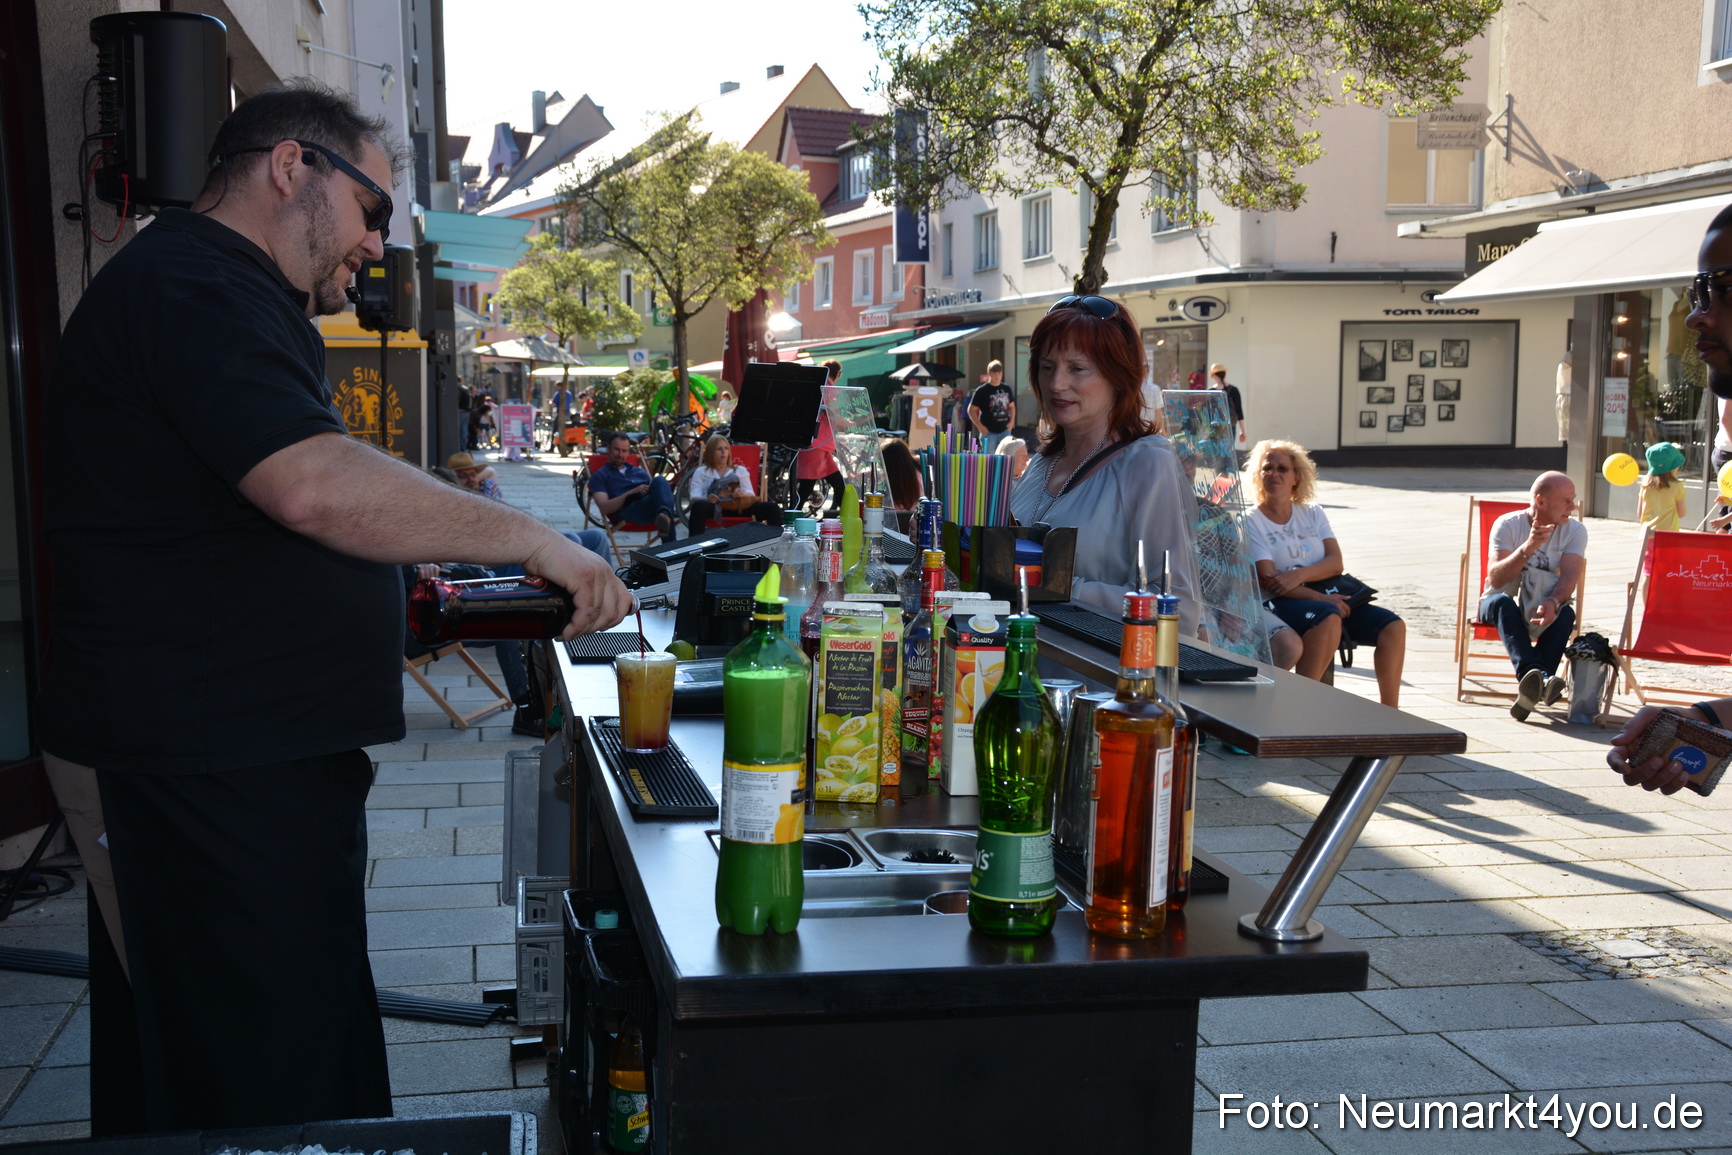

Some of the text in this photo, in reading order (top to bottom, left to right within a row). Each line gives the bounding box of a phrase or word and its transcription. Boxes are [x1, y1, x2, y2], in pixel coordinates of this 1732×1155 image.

[1383, 308, 1480, 316] TOM TAILOR
[861, 314, 888, 326] Madonna
[1605, 393, 1627, 401] HOSEN
[1666, 564, 1725, 581] aktives
[721, 598, 751, 606] PRINCE
[970, 637, 994, 645] Quality
[847, 662, 868, 672] Passion
[907, 655, 932, 671] AGAVITA
[836, 692, 861, 701] Nectar
